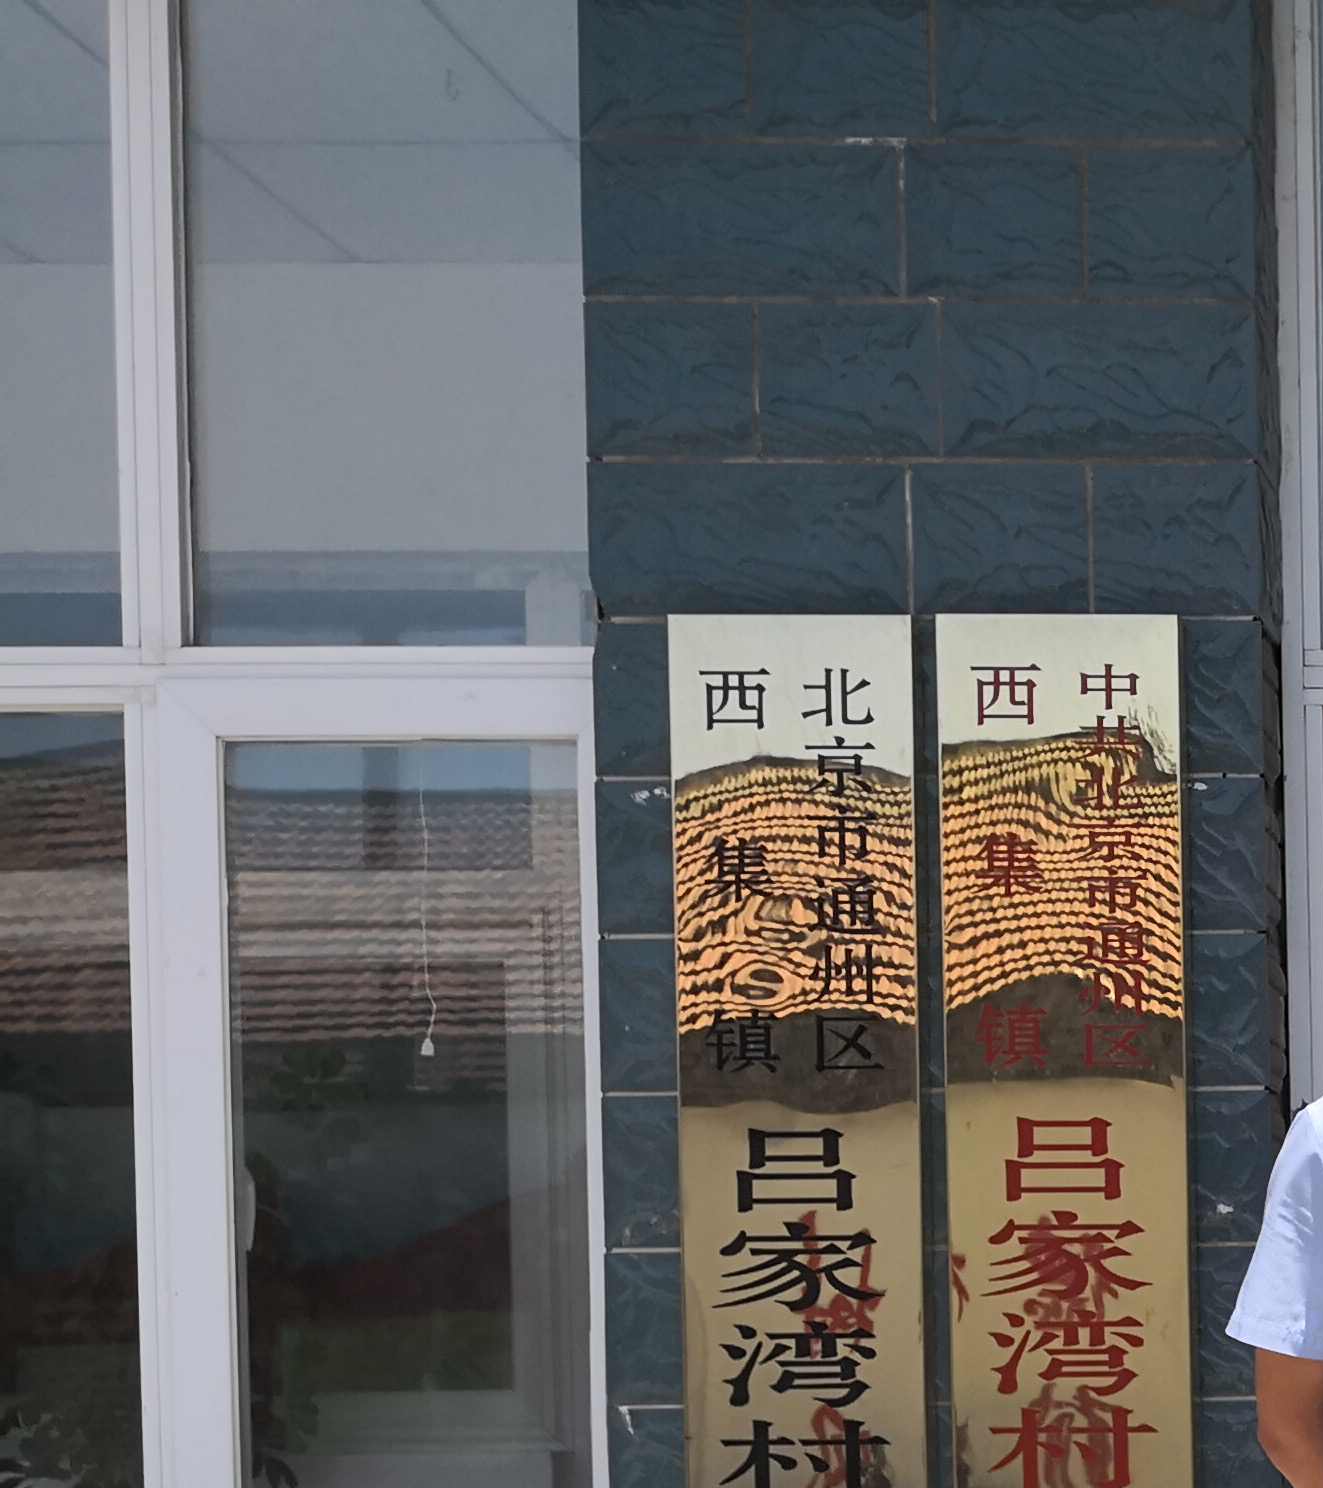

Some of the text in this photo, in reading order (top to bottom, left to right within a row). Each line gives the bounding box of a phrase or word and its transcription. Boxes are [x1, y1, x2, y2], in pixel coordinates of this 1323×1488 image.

[699, 667, 780, 1073] 西集镇
[802, 667, 884, 1072] 北京市通州区
[970, 663, 1047, 1069] 西集镇
[1071, 663, 1152, 1069] 中共北京市通州区
